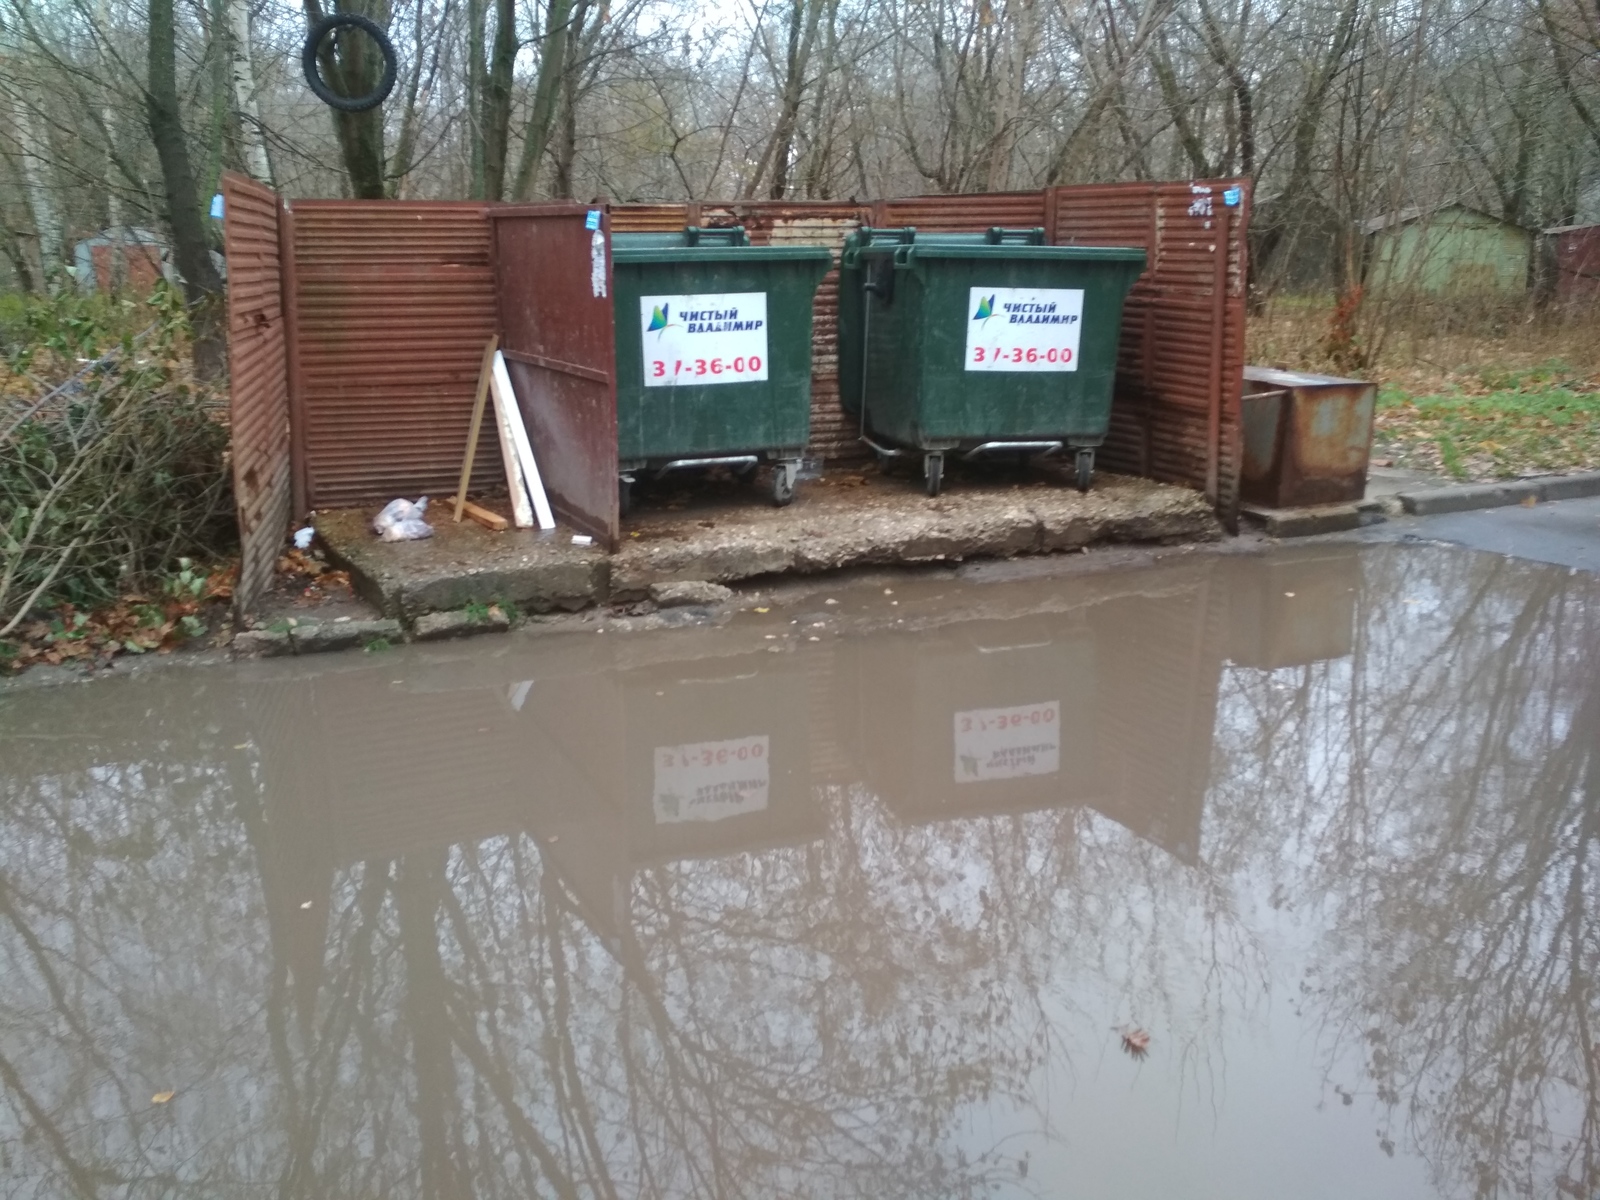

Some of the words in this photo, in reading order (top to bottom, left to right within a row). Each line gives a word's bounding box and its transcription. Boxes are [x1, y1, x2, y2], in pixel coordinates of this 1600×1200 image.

[1003, 302, 1057, 313] ЧИСТЫЙ
[679, 307, 738, 321] ЧИСТЫЙ
[1009, 314, 1078, 325] ВЛАДИМИР
[687, 320, 763, 333] ВЛАДИМИР
